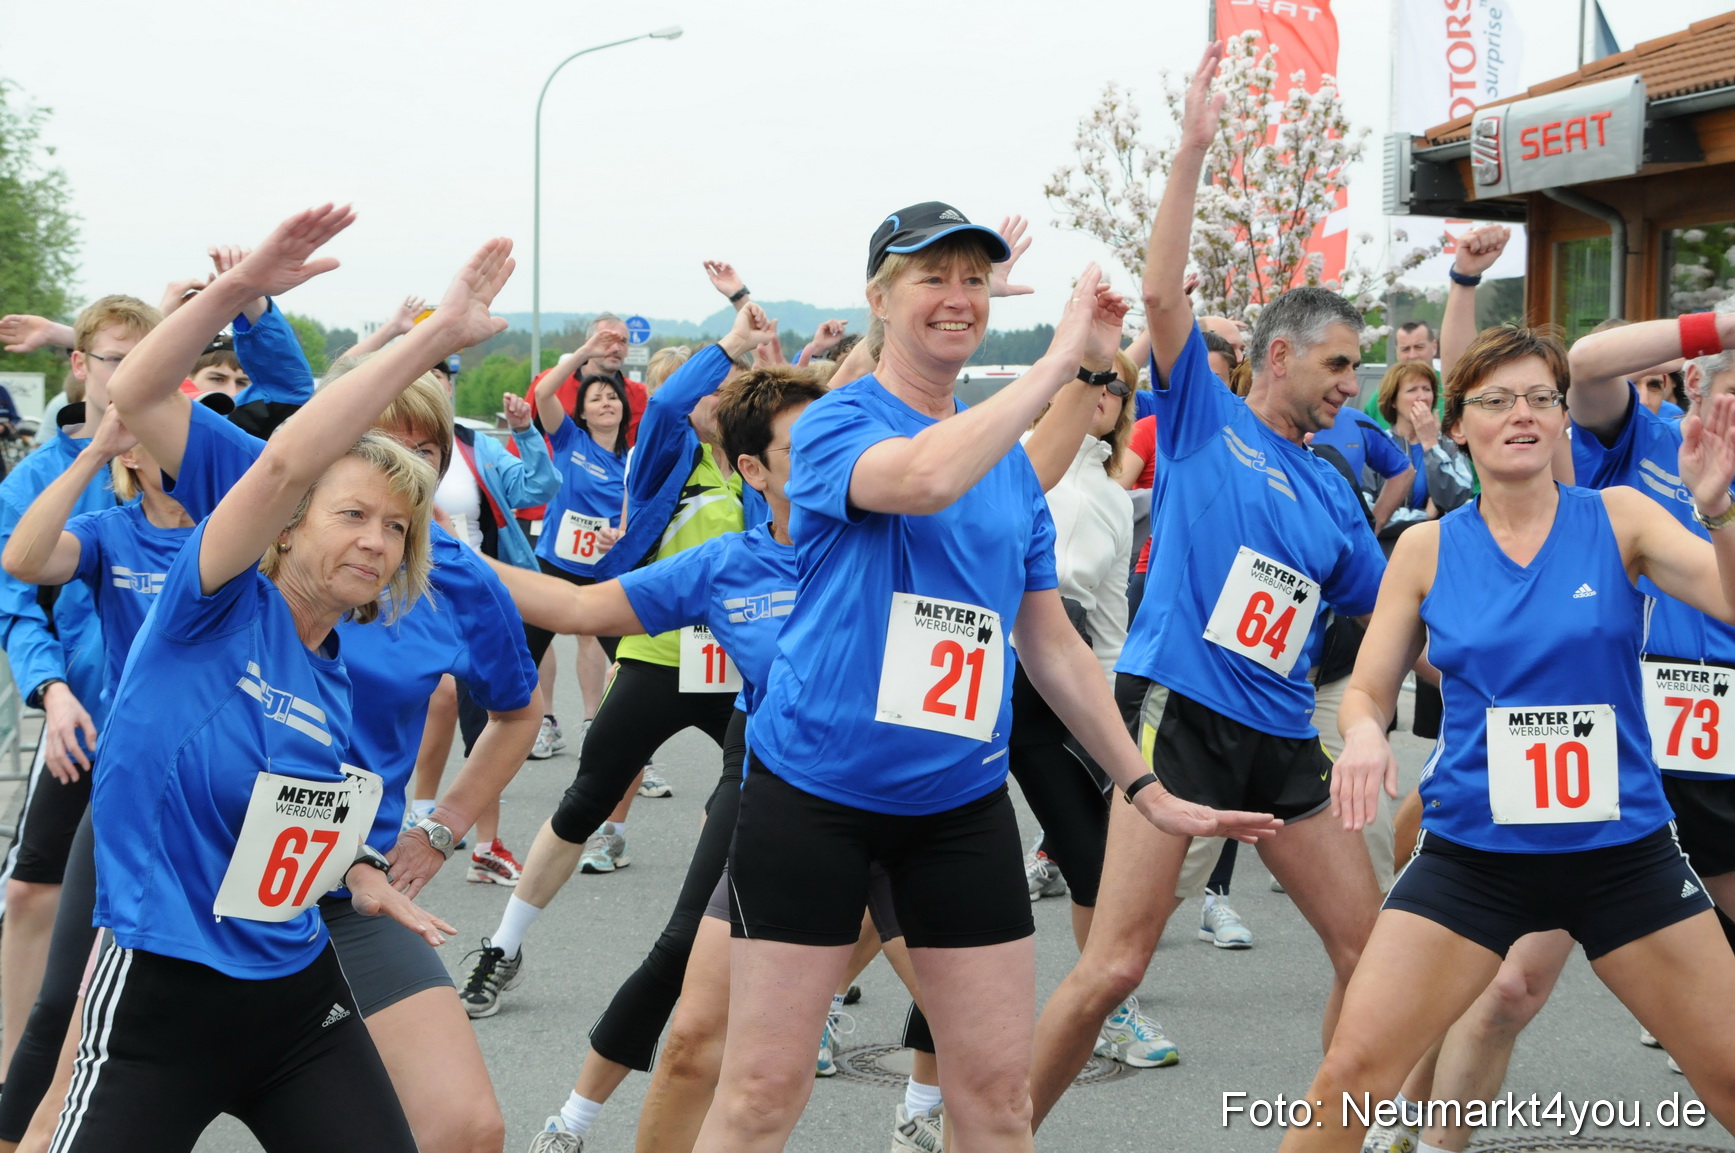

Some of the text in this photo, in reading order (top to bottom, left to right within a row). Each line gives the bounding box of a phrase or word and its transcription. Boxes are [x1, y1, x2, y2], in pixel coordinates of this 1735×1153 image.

[1230, 0, 1322, 21] EAT
[1444, 0, 1476, 122] OTORS
[1484, 7, 1504, 98] surprise
[1520, 111, 1612, 160] SEAT
[571, 515, 593, 525] MEYER
[572, 529, 596, 557] 13
[1251, 569, 1293, 596] WERBUNG
[1252, 558, 1296, 587] MEYER
[914, 617, 975, 638] WERBUNG
[915, 602, 976, 626] MEYER
[1236, 591, 1297, 660] 64
[702, 643, 726, 684] 11
[1656, 669, 1710, 684] MEYER
[922, 639, 986, 721] 21
[1656, 680, 1710, 694] WERBUNG
[1508, 711, 1568, 726] MEYER
[1508, 725, 1570, 737] WERBUNG
[1664, 695, 1720, 760] 73
[1525, 741, 1591, 809] 10
[277, 785, 335, 807] MEYER
[275, 802, 332, 820] WERBUNG
[258, 826, 340, 907] 67
[321, 1009, 350, 1027] adidas
